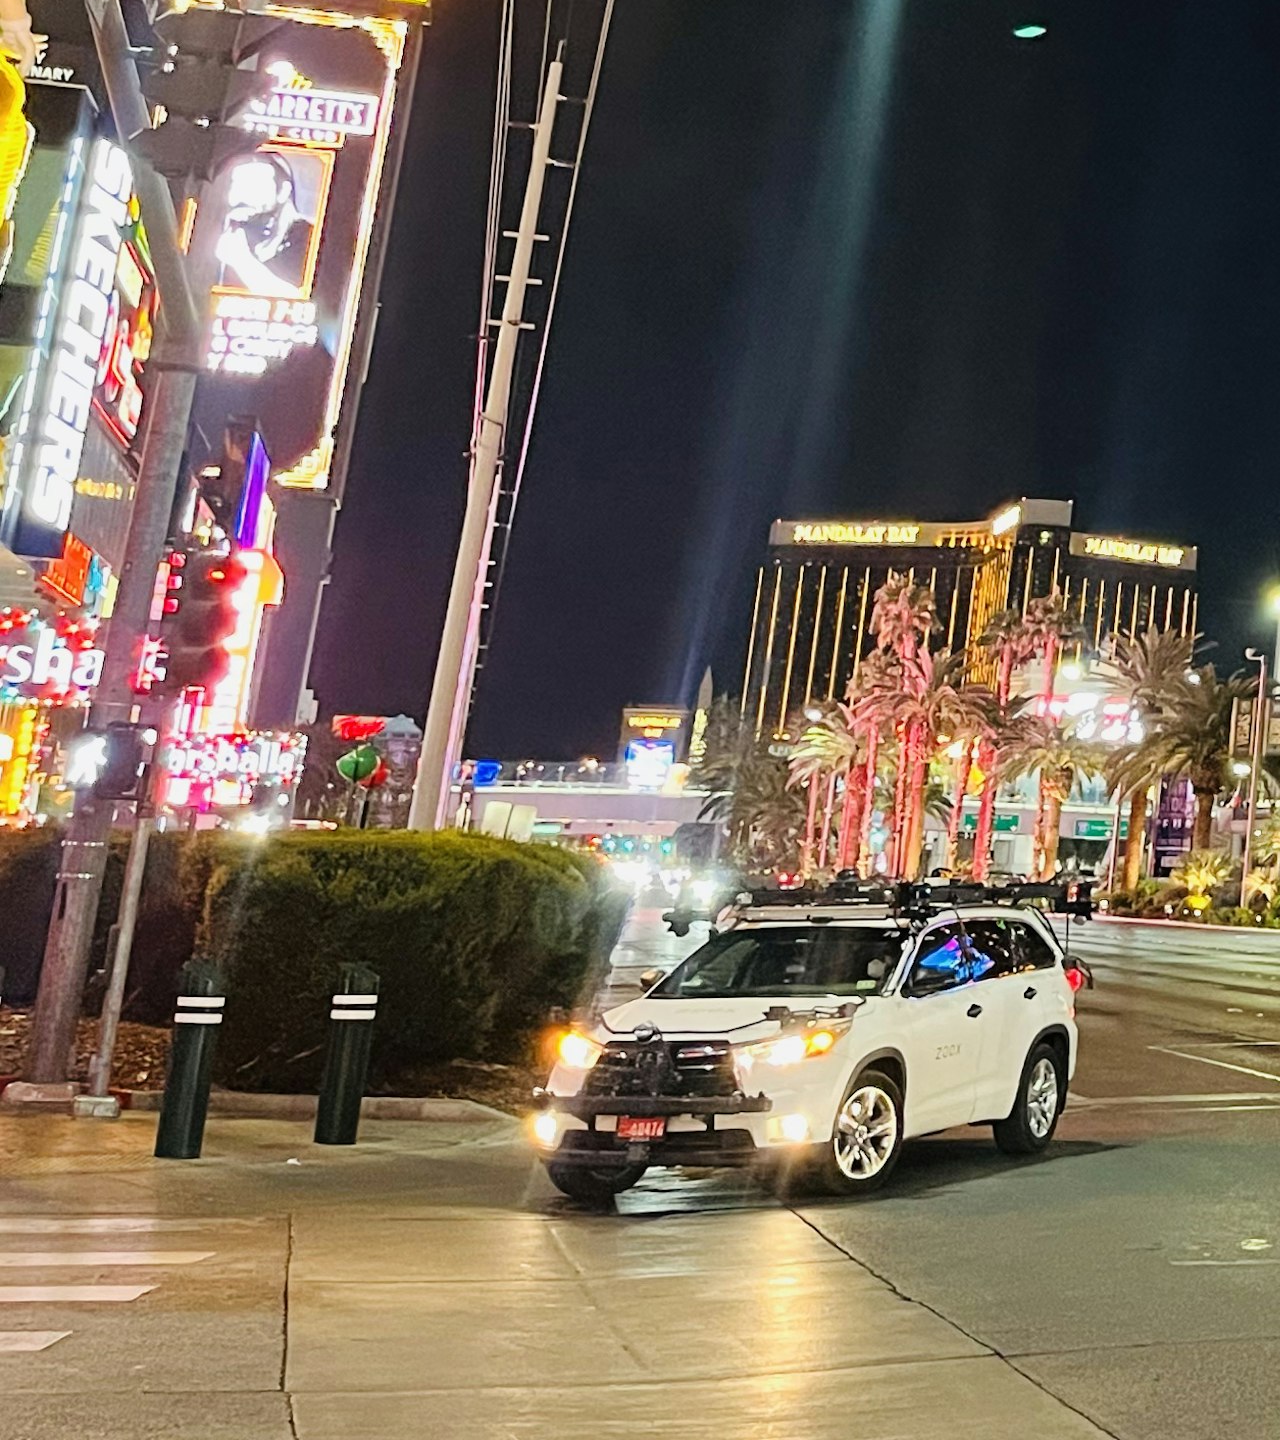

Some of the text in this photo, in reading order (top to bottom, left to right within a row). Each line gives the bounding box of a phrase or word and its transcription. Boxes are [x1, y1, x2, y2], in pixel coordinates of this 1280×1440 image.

[30, 65, 74, 81] NARY
[31, 135, 133, 532] SKECHERS
[794, 525, 919, 543] MANDALAY BAY
[1085, 537, 1157, 562] MANDALAY
